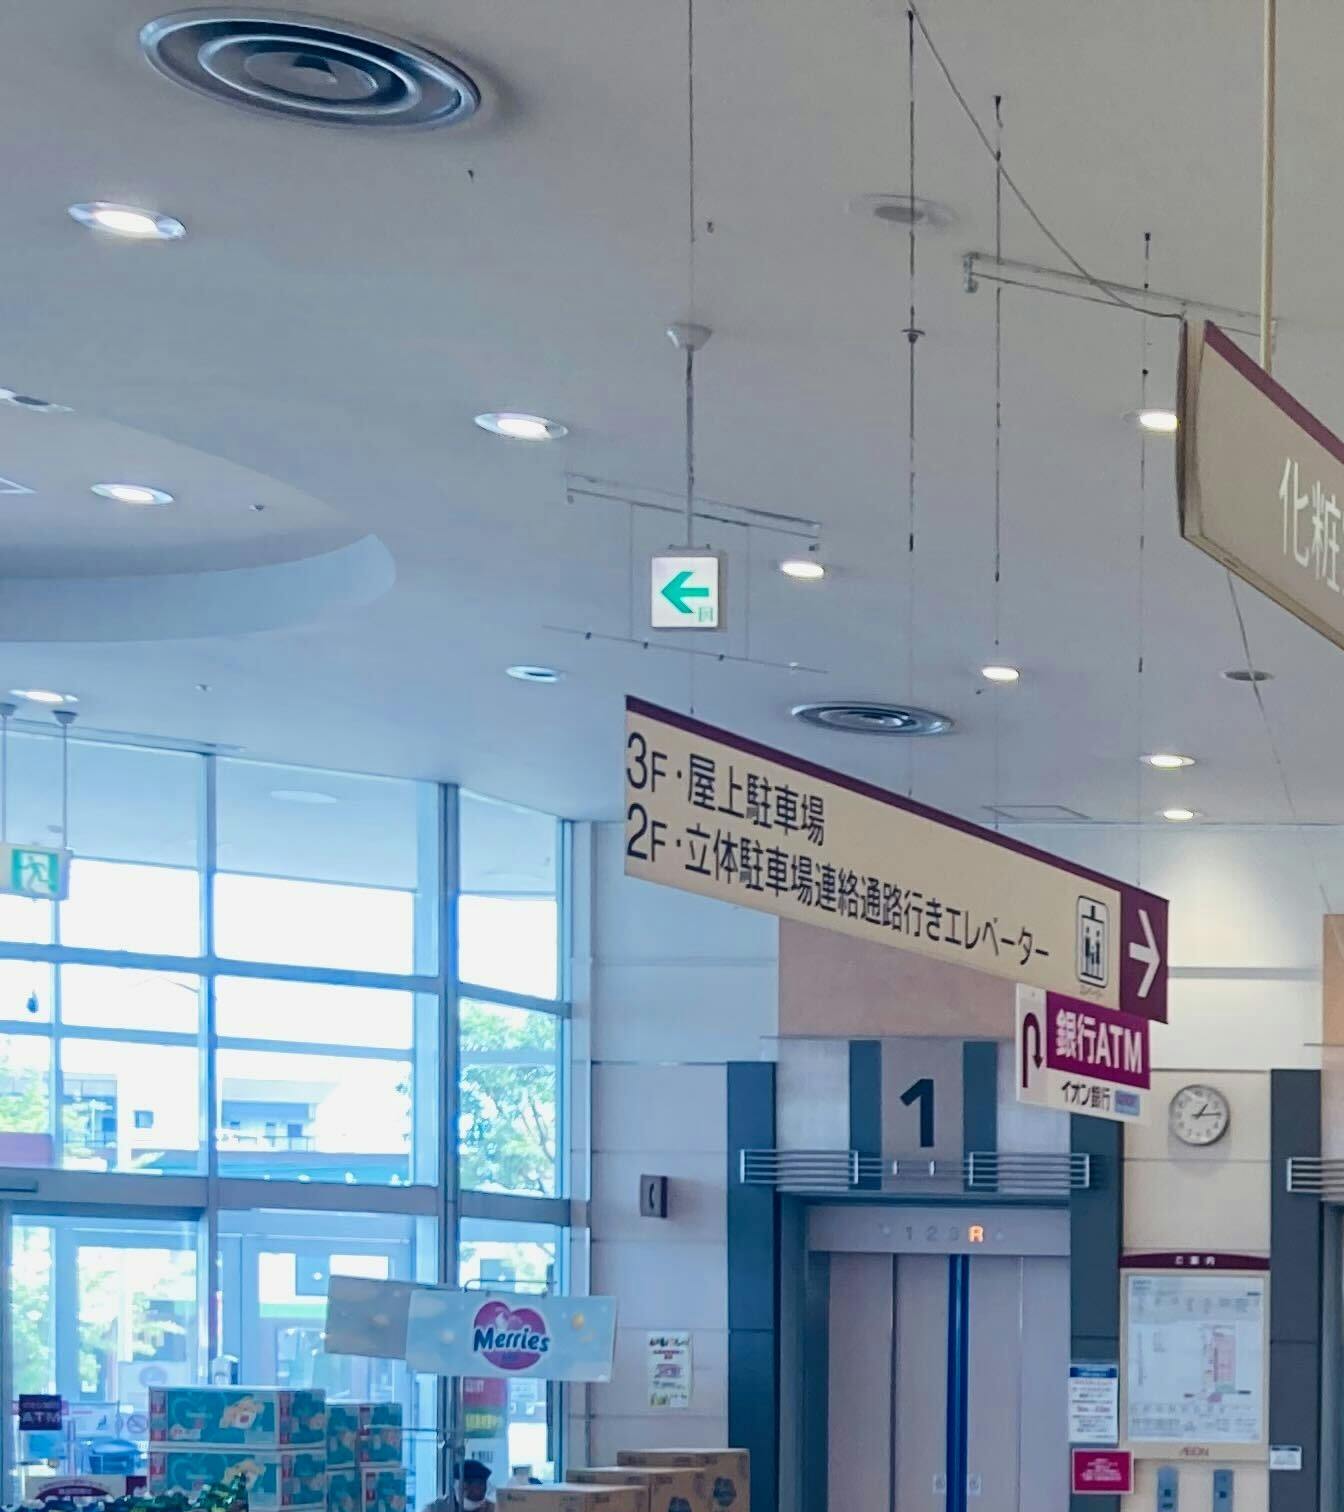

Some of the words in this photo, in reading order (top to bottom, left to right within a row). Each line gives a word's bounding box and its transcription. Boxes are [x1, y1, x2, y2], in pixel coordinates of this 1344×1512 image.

[1056, 1009, 1143, 1074] 銀行ATM
[1060, 1080, 1111, 1112] イオン銀行
[900, 1079, 934, 1148] 1
[968, 1225, 984, 1243] R
[473, 1327, 550, 1352] Merries
